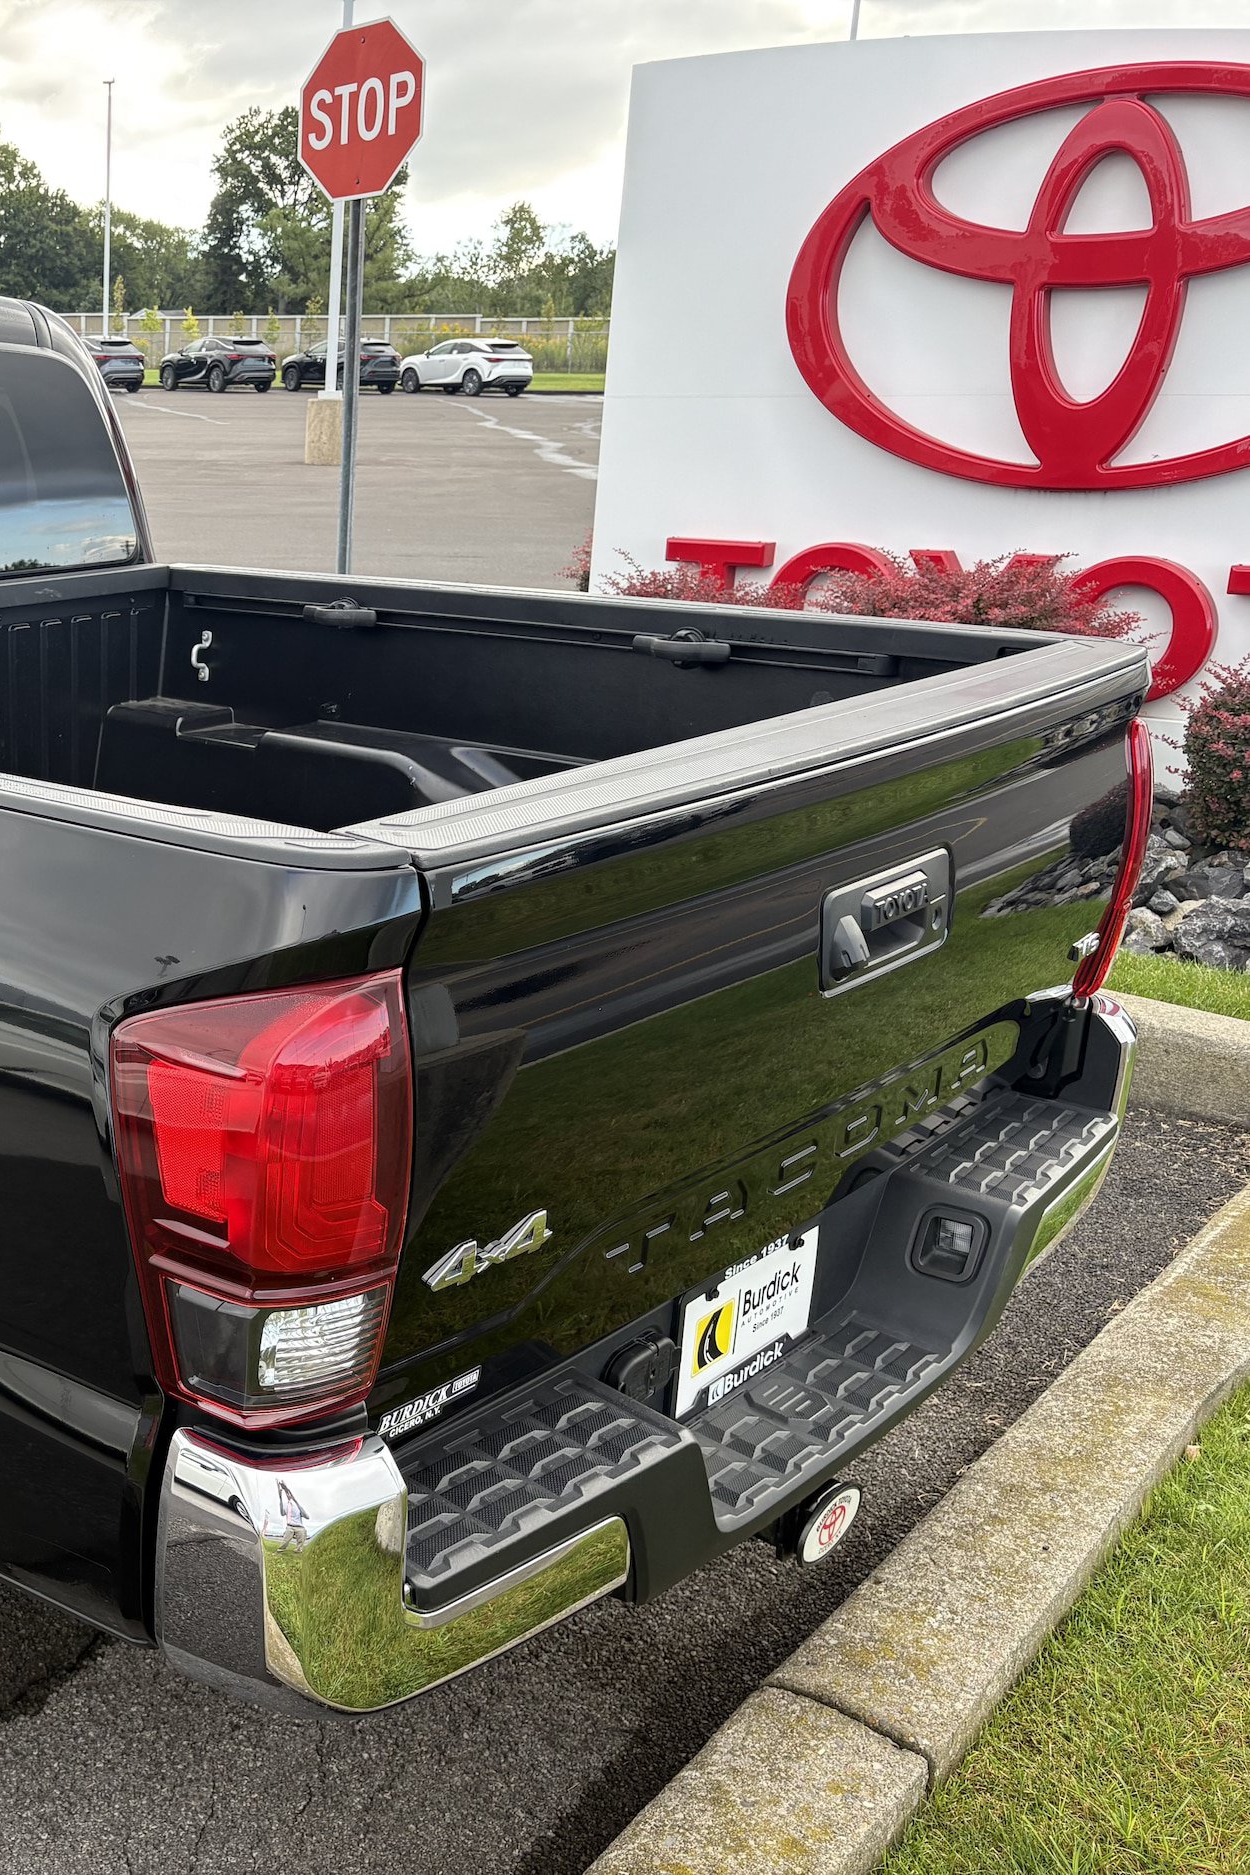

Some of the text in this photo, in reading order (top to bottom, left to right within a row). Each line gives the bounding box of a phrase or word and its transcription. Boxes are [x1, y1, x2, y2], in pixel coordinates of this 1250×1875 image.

[308, 70, 416, 151] STOP
[666, 537, 1250, 704] TOO
[874, 882, 929, 924] TOYOTA
[606, 1038, 988, 1274] TACOMA
[724, 1233, 790, 1280] Since 1937
[740, 1286, 800, 1327] AUTOMOTIVE
[742, 1261, 802, 1317] Burdick
[752, 1305, 784, 1333] Since 1937
[724, 1341, 784, 1395] Burdick
[378, 1369, 480, 1433] BURDICK TOYOTA
[389, 1405, 440, 1438] CICERO, N.Y.
